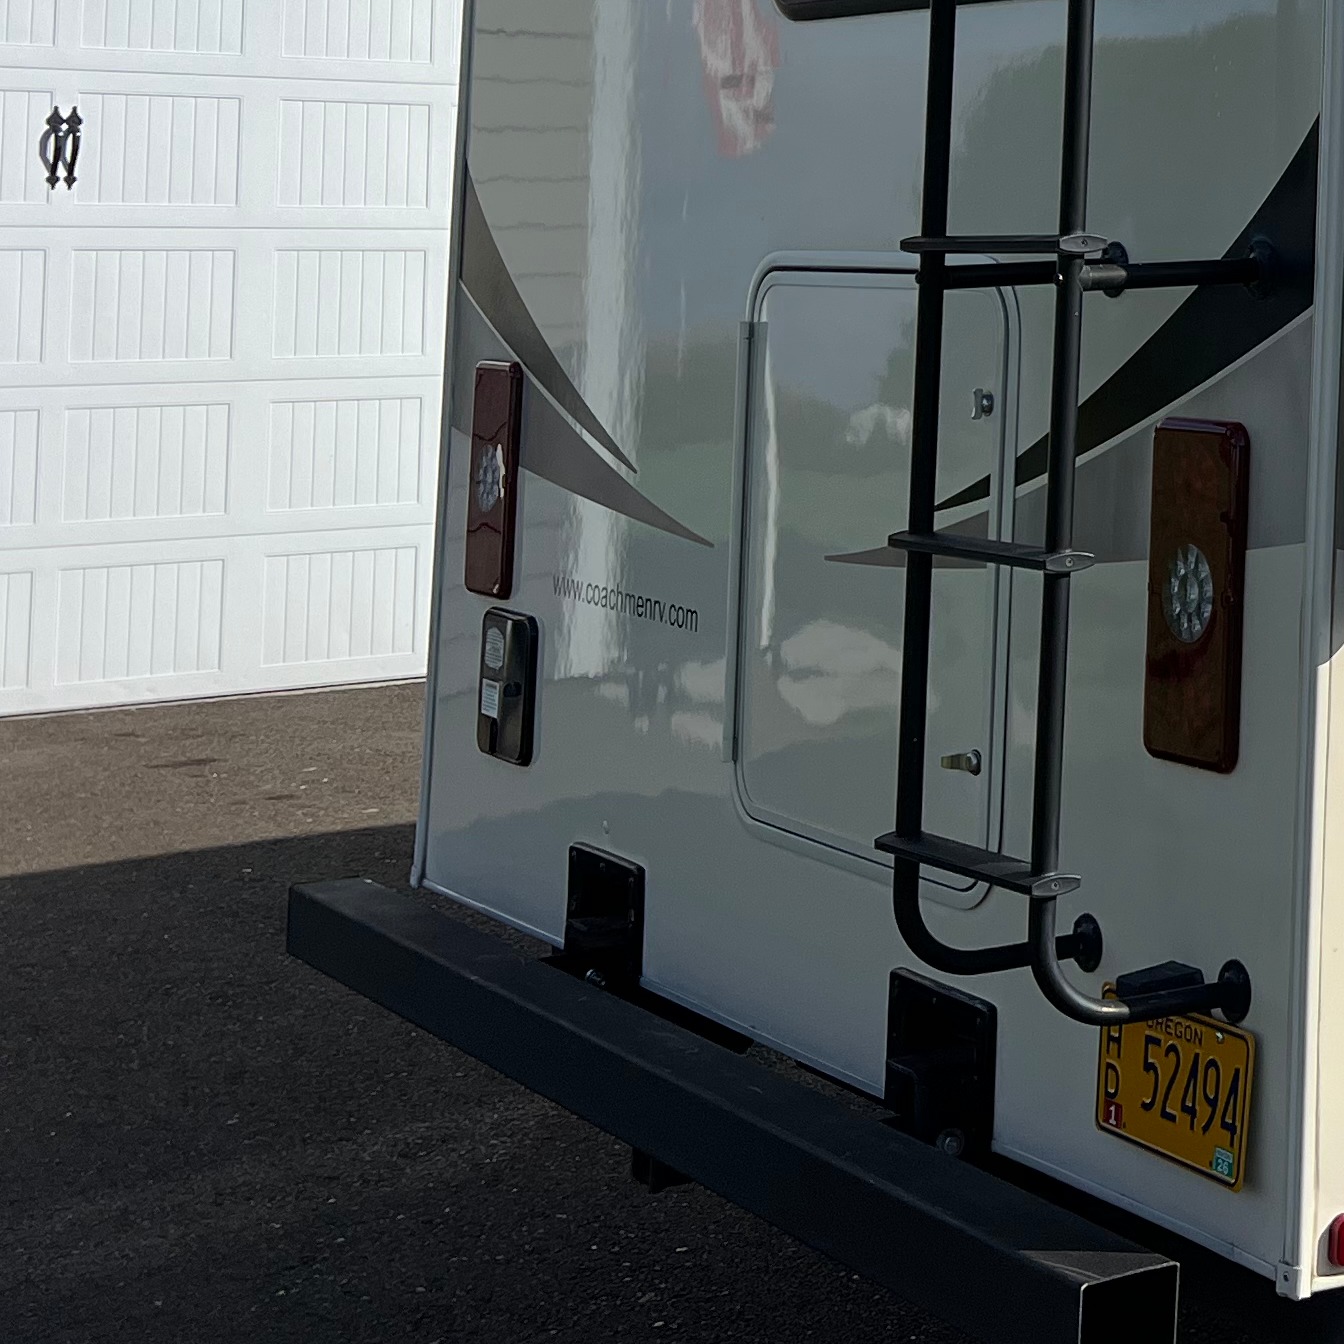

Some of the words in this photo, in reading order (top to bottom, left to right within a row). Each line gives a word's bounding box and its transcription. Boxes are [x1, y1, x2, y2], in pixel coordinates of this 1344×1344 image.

[552, 575, 699, 633] www.coachmenrv.com
[1108, 1104, 1117, 1126] 1
[1140, 1033, 1241, 1149] 52494
